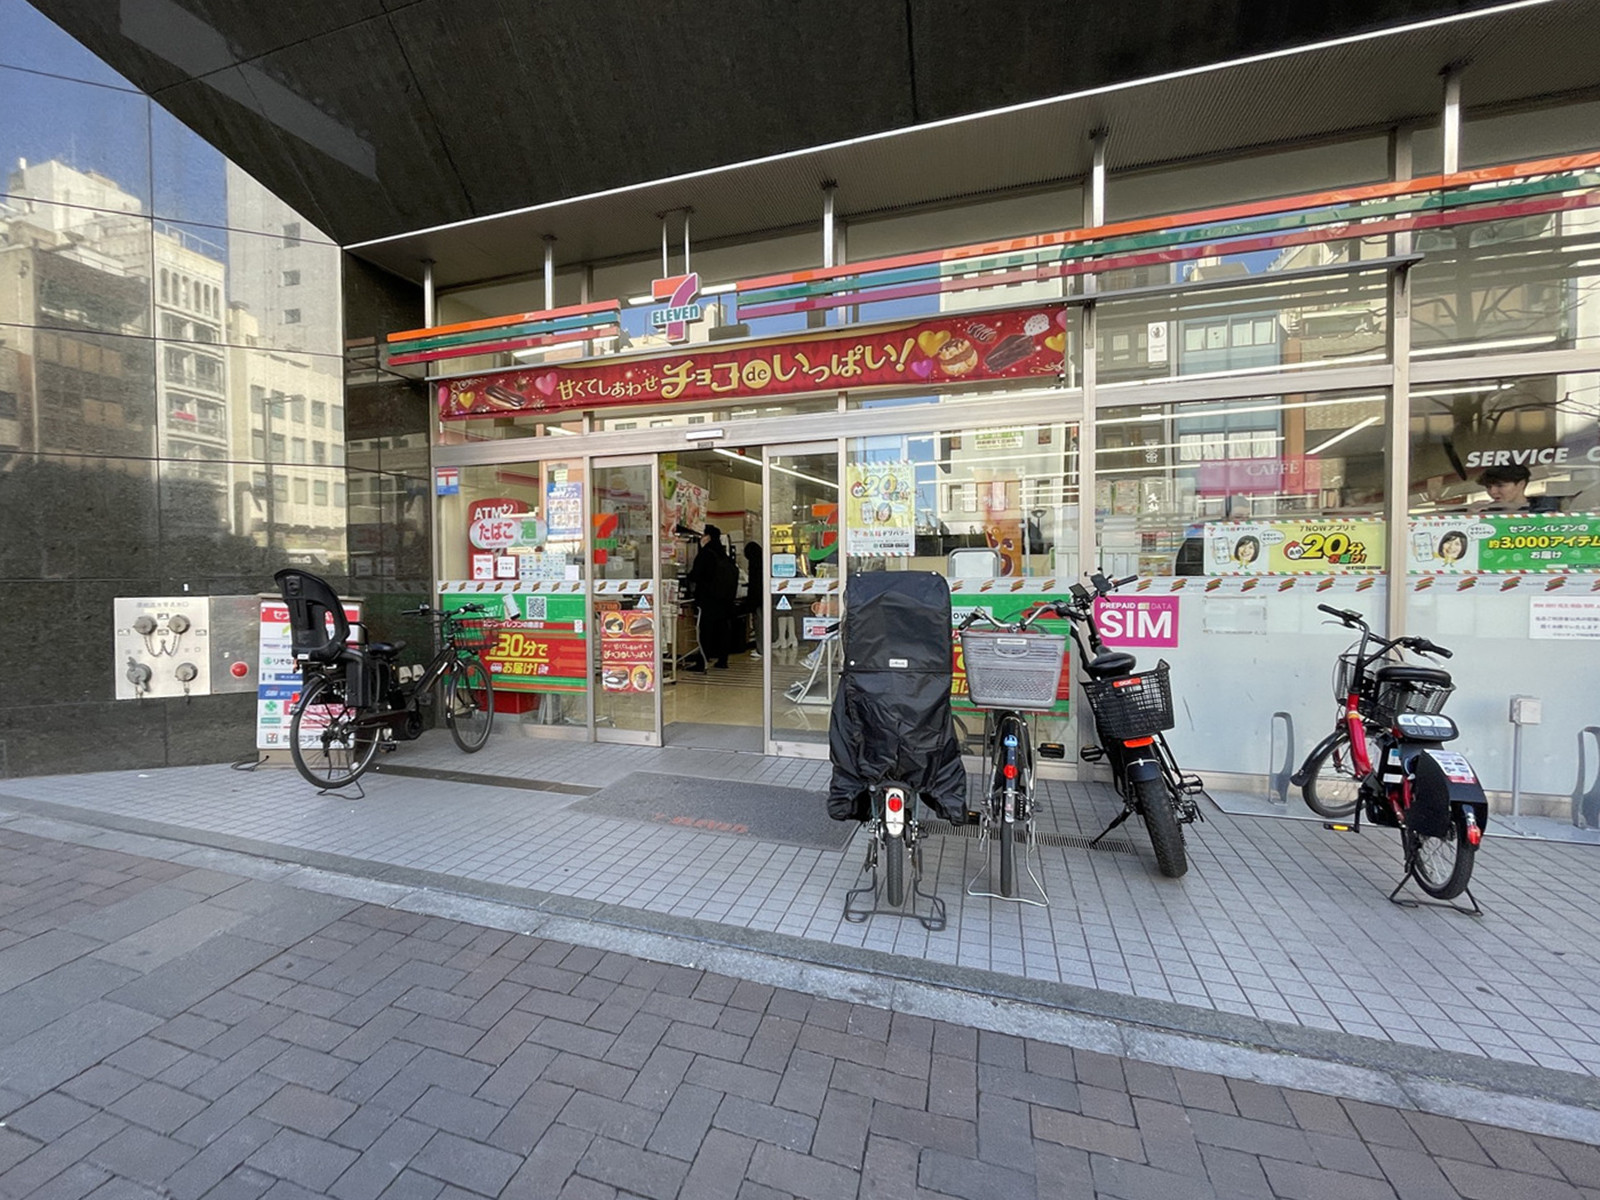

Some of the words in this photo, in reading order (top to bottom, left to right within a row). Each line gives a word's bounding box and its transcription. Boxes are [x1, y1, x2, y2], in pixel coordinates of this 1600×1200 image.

[557, 376, 659, 401] 甘くてしあわせ
[1466, 448, 1569, 468] SERVICE
[474, 506, 501, 520] ATM
[479, 522, 514, 541] たばこ
[1100, 610, 1172, 638] SIM
